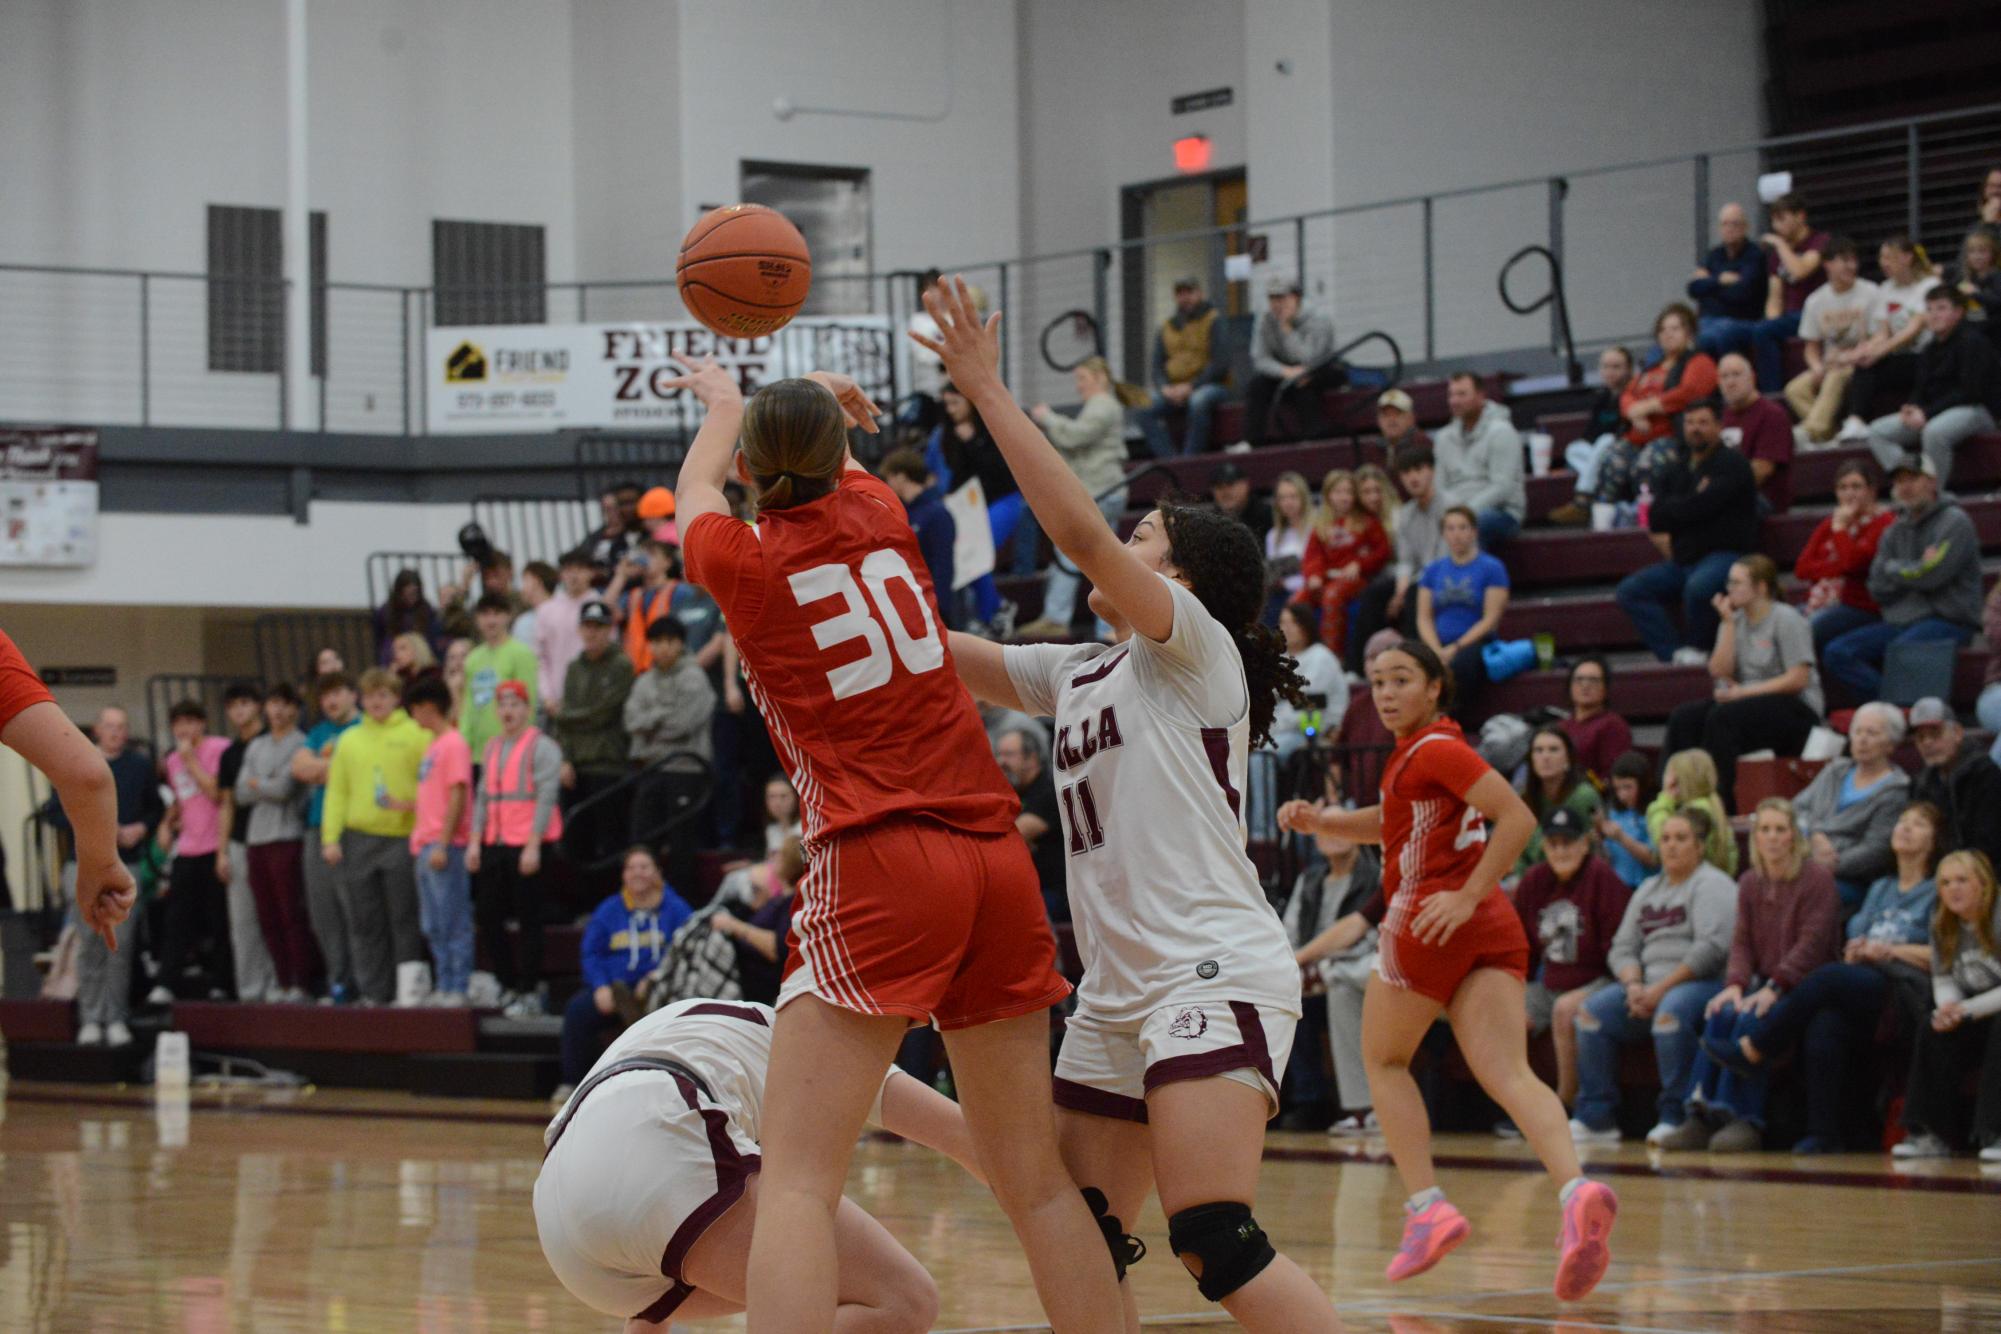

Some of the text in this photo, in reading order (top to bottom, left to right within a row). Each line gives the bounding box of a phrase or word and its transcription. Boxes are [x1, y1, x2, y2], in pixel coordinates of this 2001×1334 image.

[615, 364, 765, 400] ZOE
[787, 548, 944, 701] 30
[1061, 776, 1105, 857] 11
